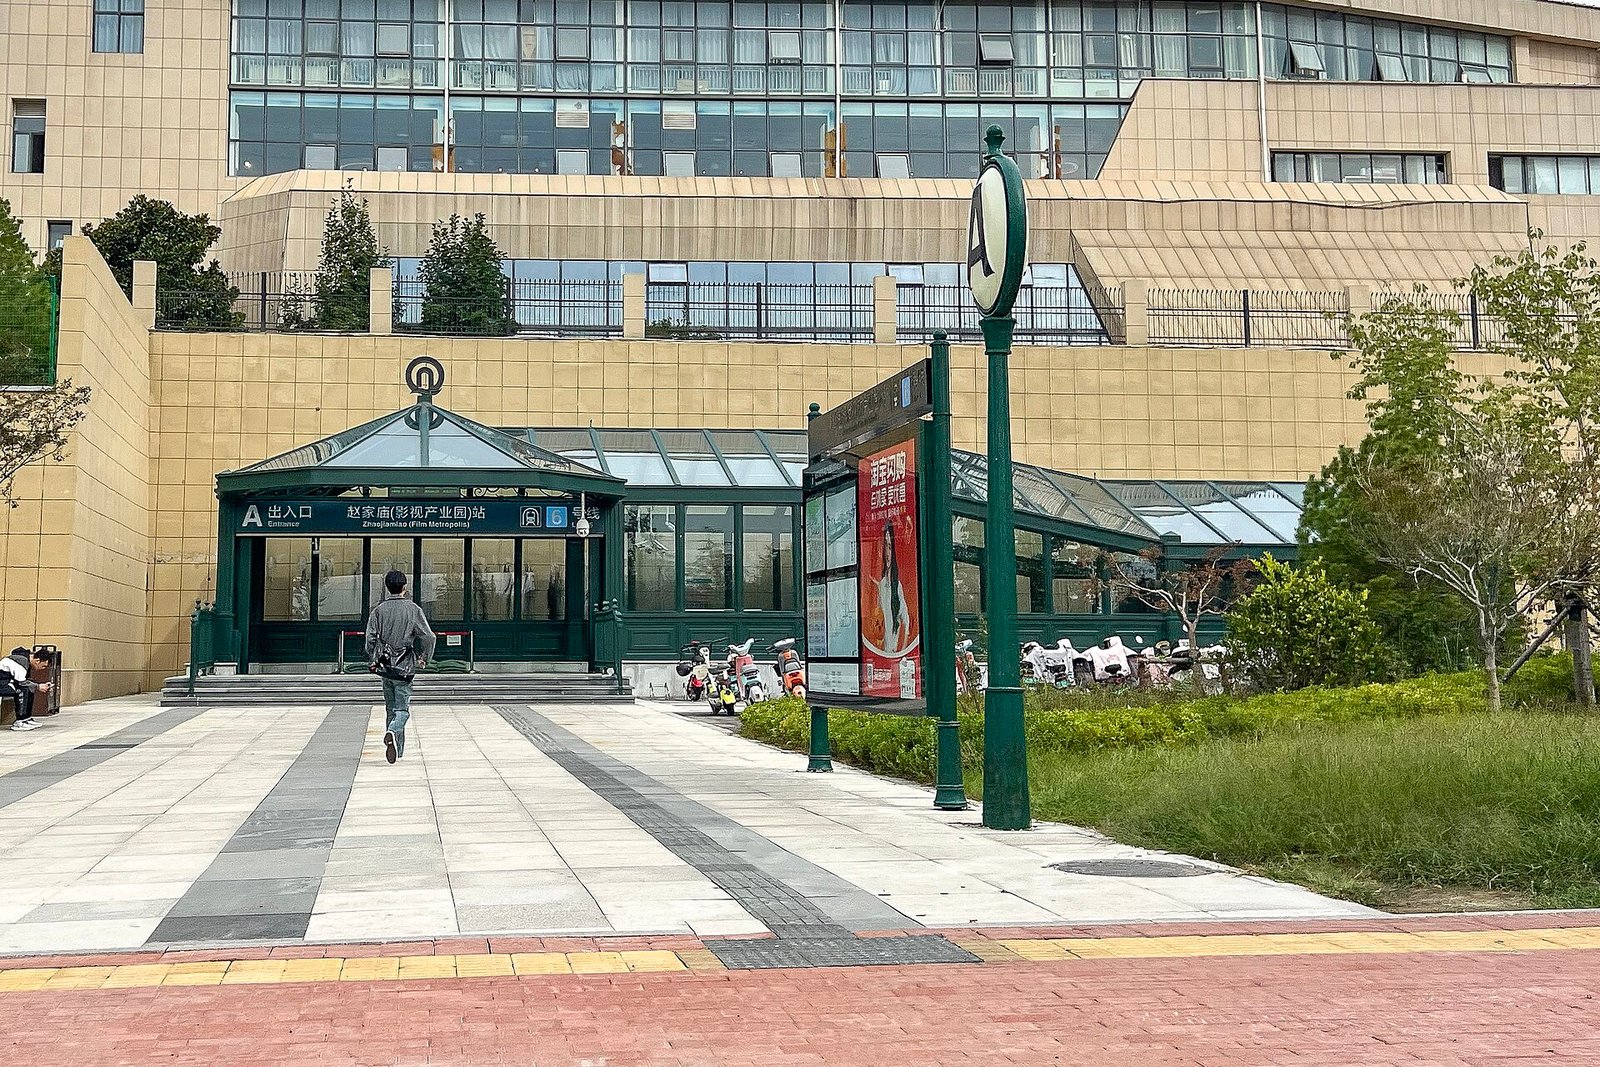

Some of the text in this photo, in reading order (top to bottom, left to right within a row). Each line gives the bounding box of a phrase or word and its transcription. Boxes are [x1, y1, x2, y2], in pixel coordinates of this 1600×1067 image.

[968, 182, 995, 291] A
[870, 451, 907, 488] 淘宝闪购
[242, 504, 263, 527] A
[267, 504, 312, 519] 出入口
[346, 505, 486, 519] 赵家庙(影视产业园)站
[551, 509, 562, 525] 6
[572, 506, 600, 520] 号线
[362, 520, 470, 529] Zhaojiamiao (Film Metropolis)
